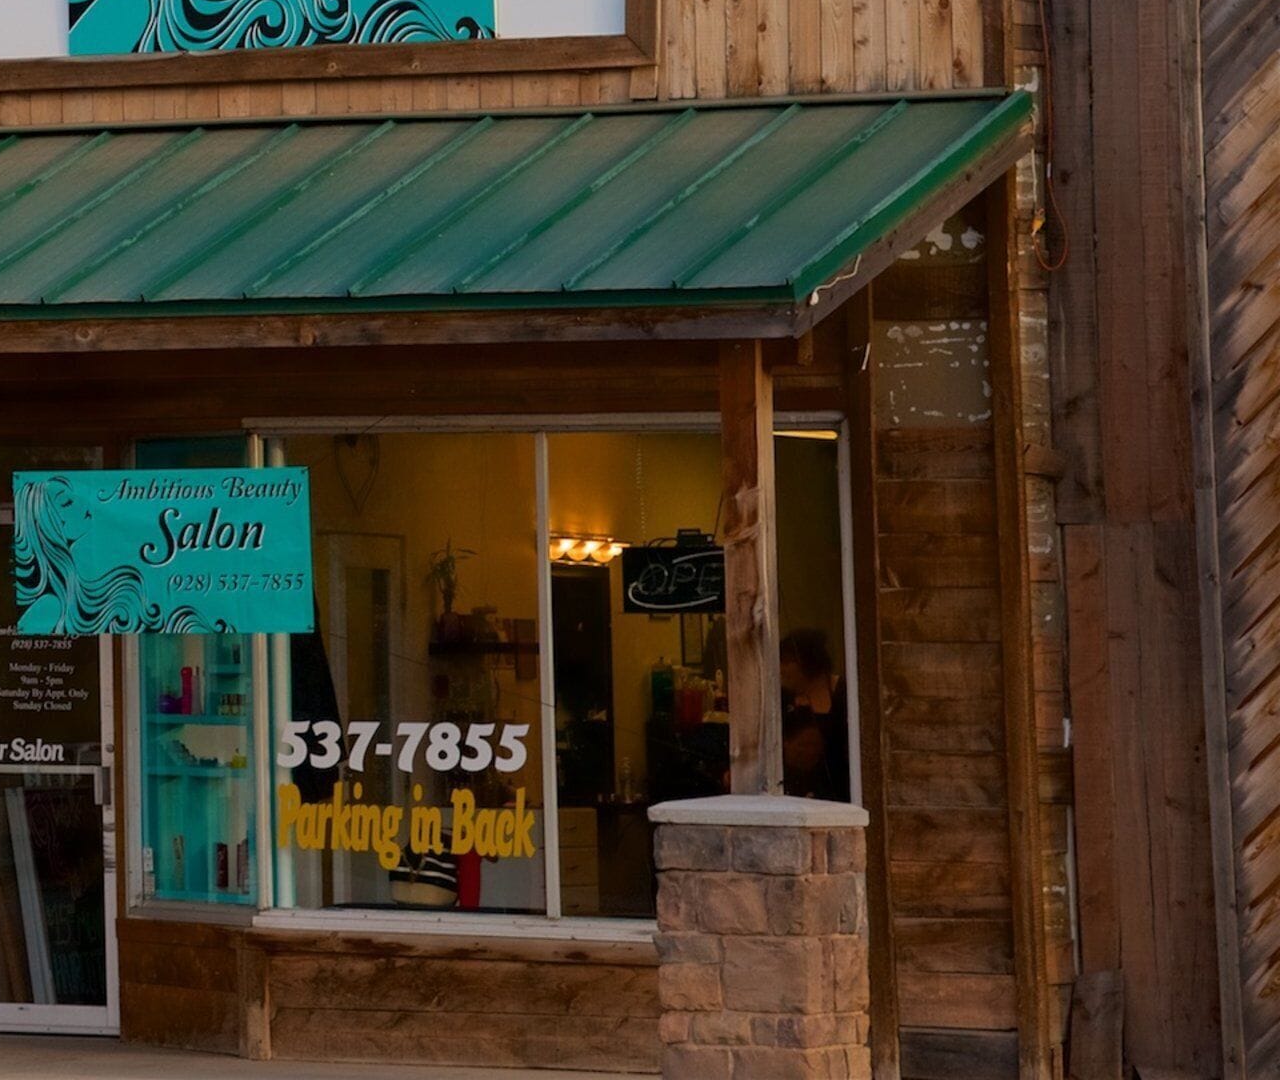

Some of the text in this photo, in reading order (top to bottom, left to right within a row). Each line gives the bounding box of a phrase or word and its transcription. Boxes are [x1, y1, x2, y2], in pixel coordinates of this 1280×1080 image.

[96, 475, 304, 504] Ambitious Beauty
[139, 506, 266, 569] Salon
[166, 571, 306, 596] (928) 537-7855
[638, 562, 722, 596] OPE
[8, 663, 43, 674] Monday
[49, 663, 75, 674] Friday
[12, 700, 73, 712] Sunday Closed
[31, 688, 44, 700] By
[68, 688, 89, 700] Only
[8, 737, 65, 762] Salon
[276, 719, 531, 773] 537-7855
[275, 782, 536, 870] Parking in Back
